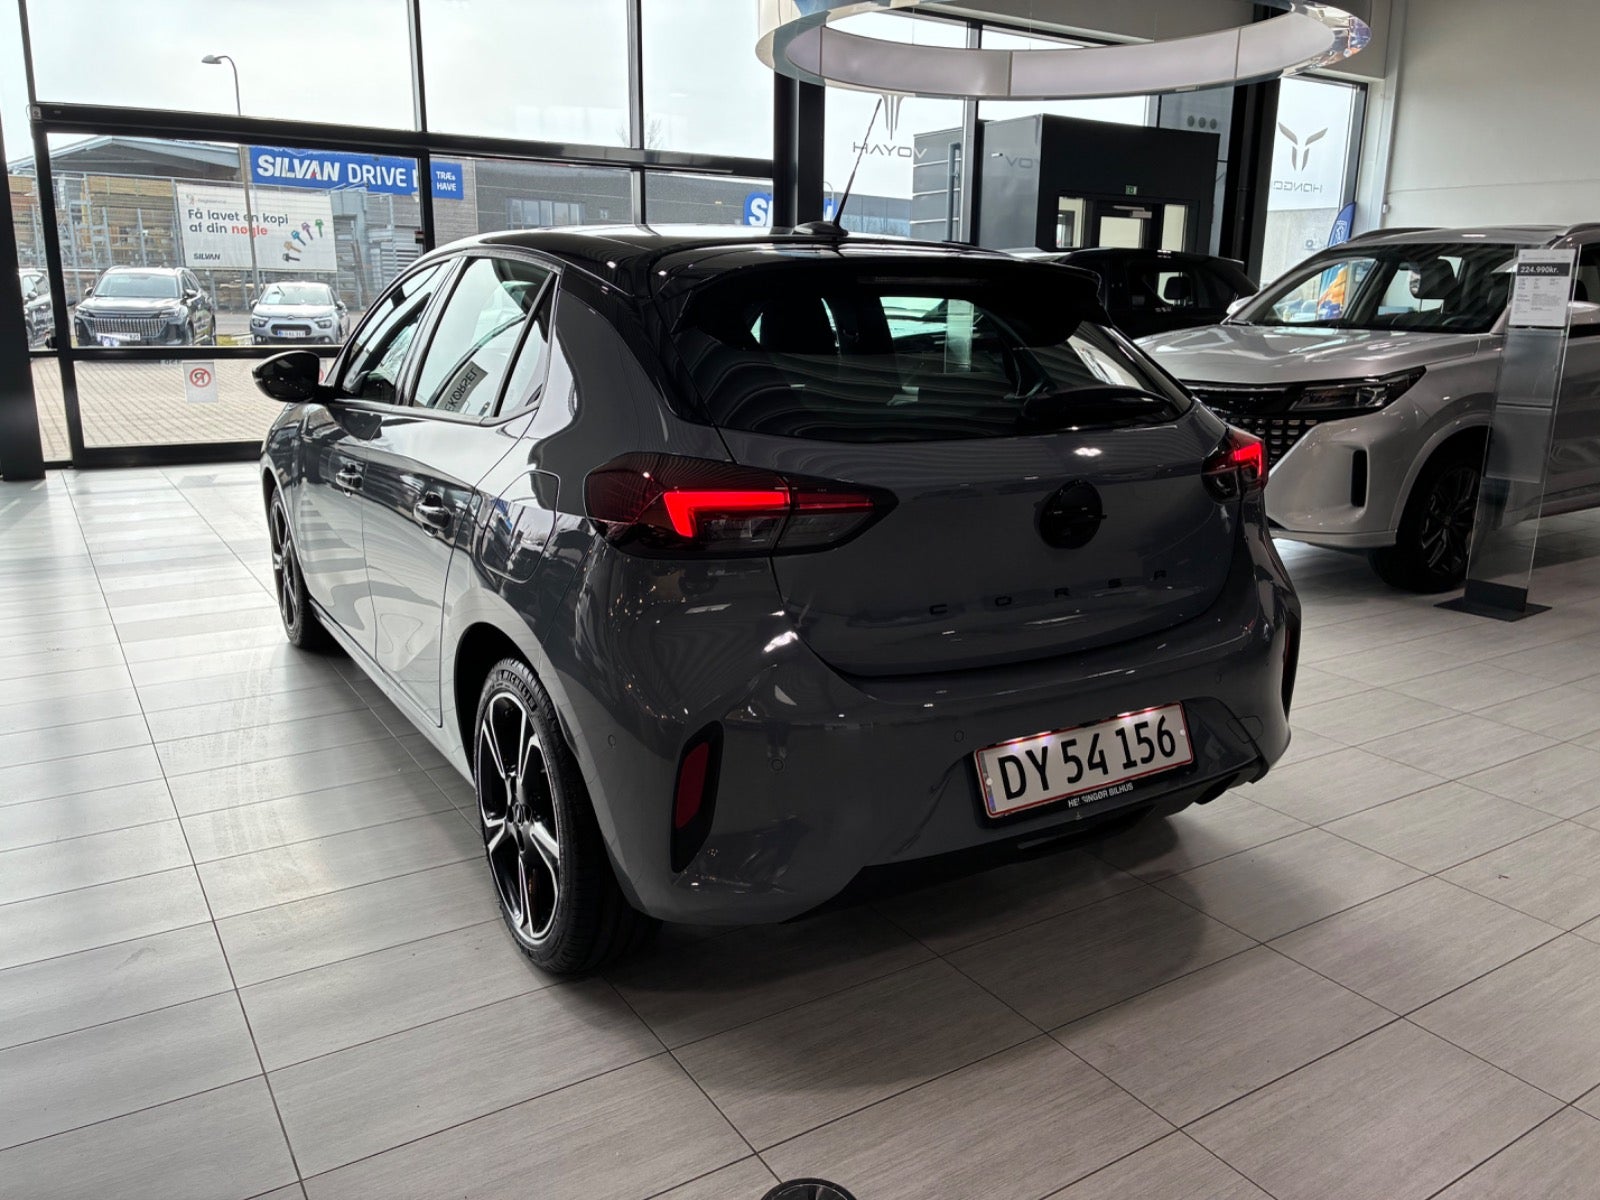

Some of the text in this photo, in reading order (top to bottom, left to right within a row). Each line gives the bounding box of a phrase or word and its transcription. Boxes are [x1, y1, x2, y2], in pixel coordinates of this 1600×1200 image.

[257, 155, 340, 182] SILVAN
[349, 163, 407, 187] DRIVE
[436, 181, 457, 192] HAVE
[188, 207, 204, 221] Få
[208, 209, 239, 222] lavet
[263, 213, 289, 227] kopi
[189, 222, 203, 233] af
[206, 222, 227, 234] din
[998, 715, 1176, 800] DY 54 156
[1108, 782, 1134, 797] BILHUS
